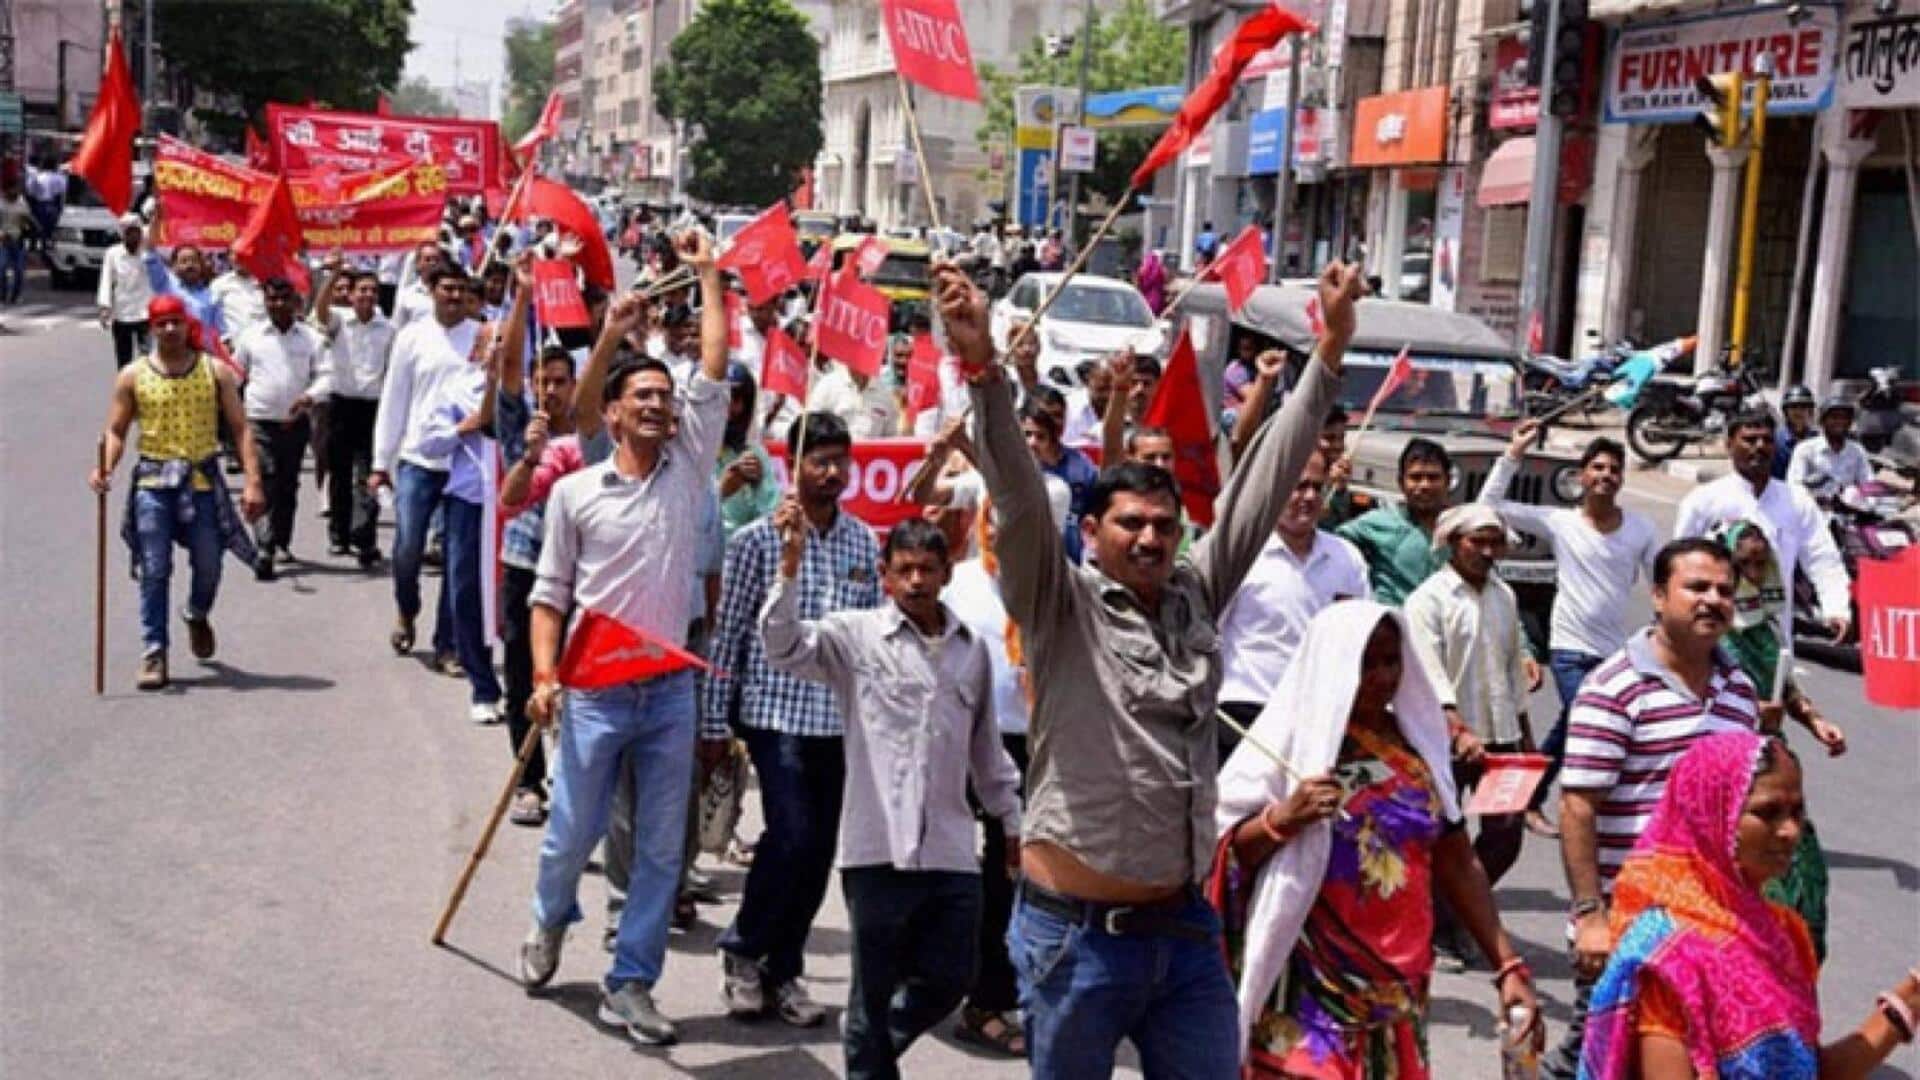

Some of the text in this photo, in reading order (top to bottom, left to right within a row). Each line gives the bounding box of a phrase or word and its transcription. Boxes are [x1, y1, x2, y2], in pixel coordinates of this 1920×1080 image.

[894, 8, 968, 65] AITUC
[1618, 30, 1823, 93] FURNITURE
[822, 295, 887, 350] ITUC
